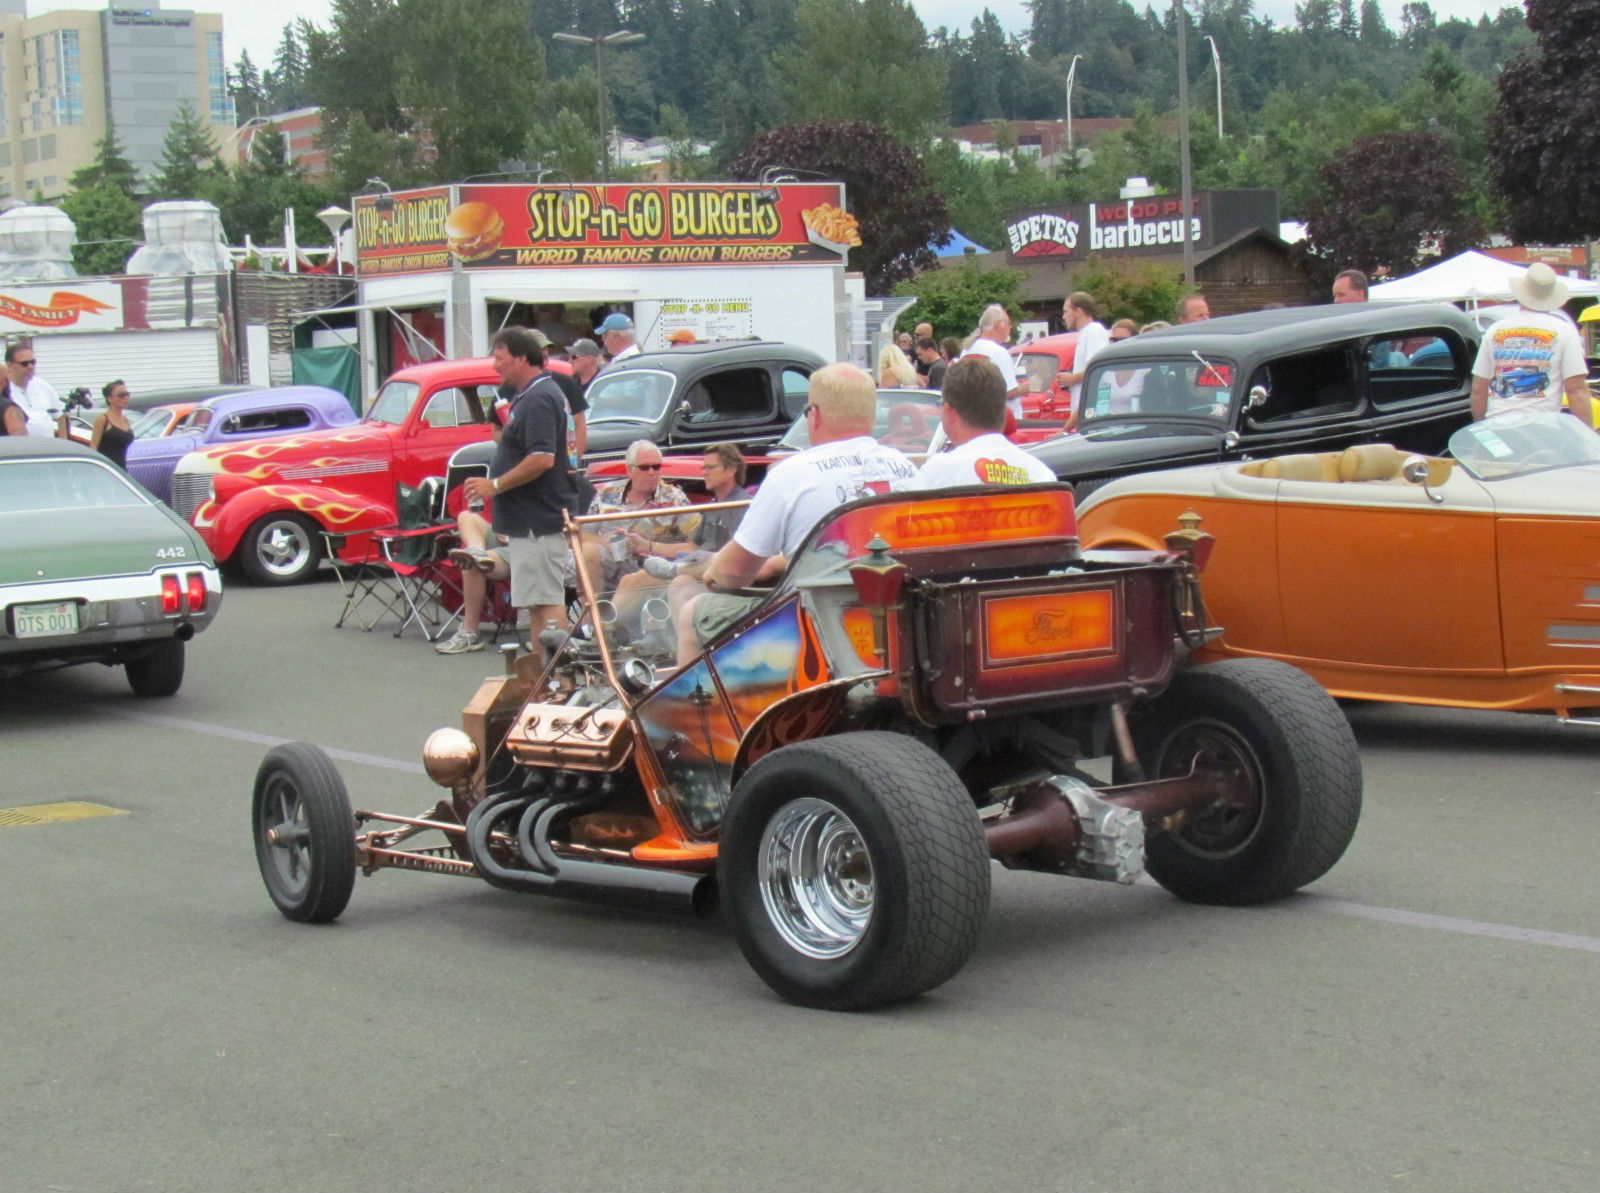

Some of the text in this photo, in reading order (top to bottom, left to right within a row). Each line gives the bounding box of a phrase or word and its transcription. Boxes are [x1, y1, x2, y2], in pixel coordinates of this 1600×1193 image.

[670, 191, 779, 237] BURGERS
[516, 245, 794, 266] WORLD FAMOUS ONION BURGERS
[157, 547, 186, 559] 442
